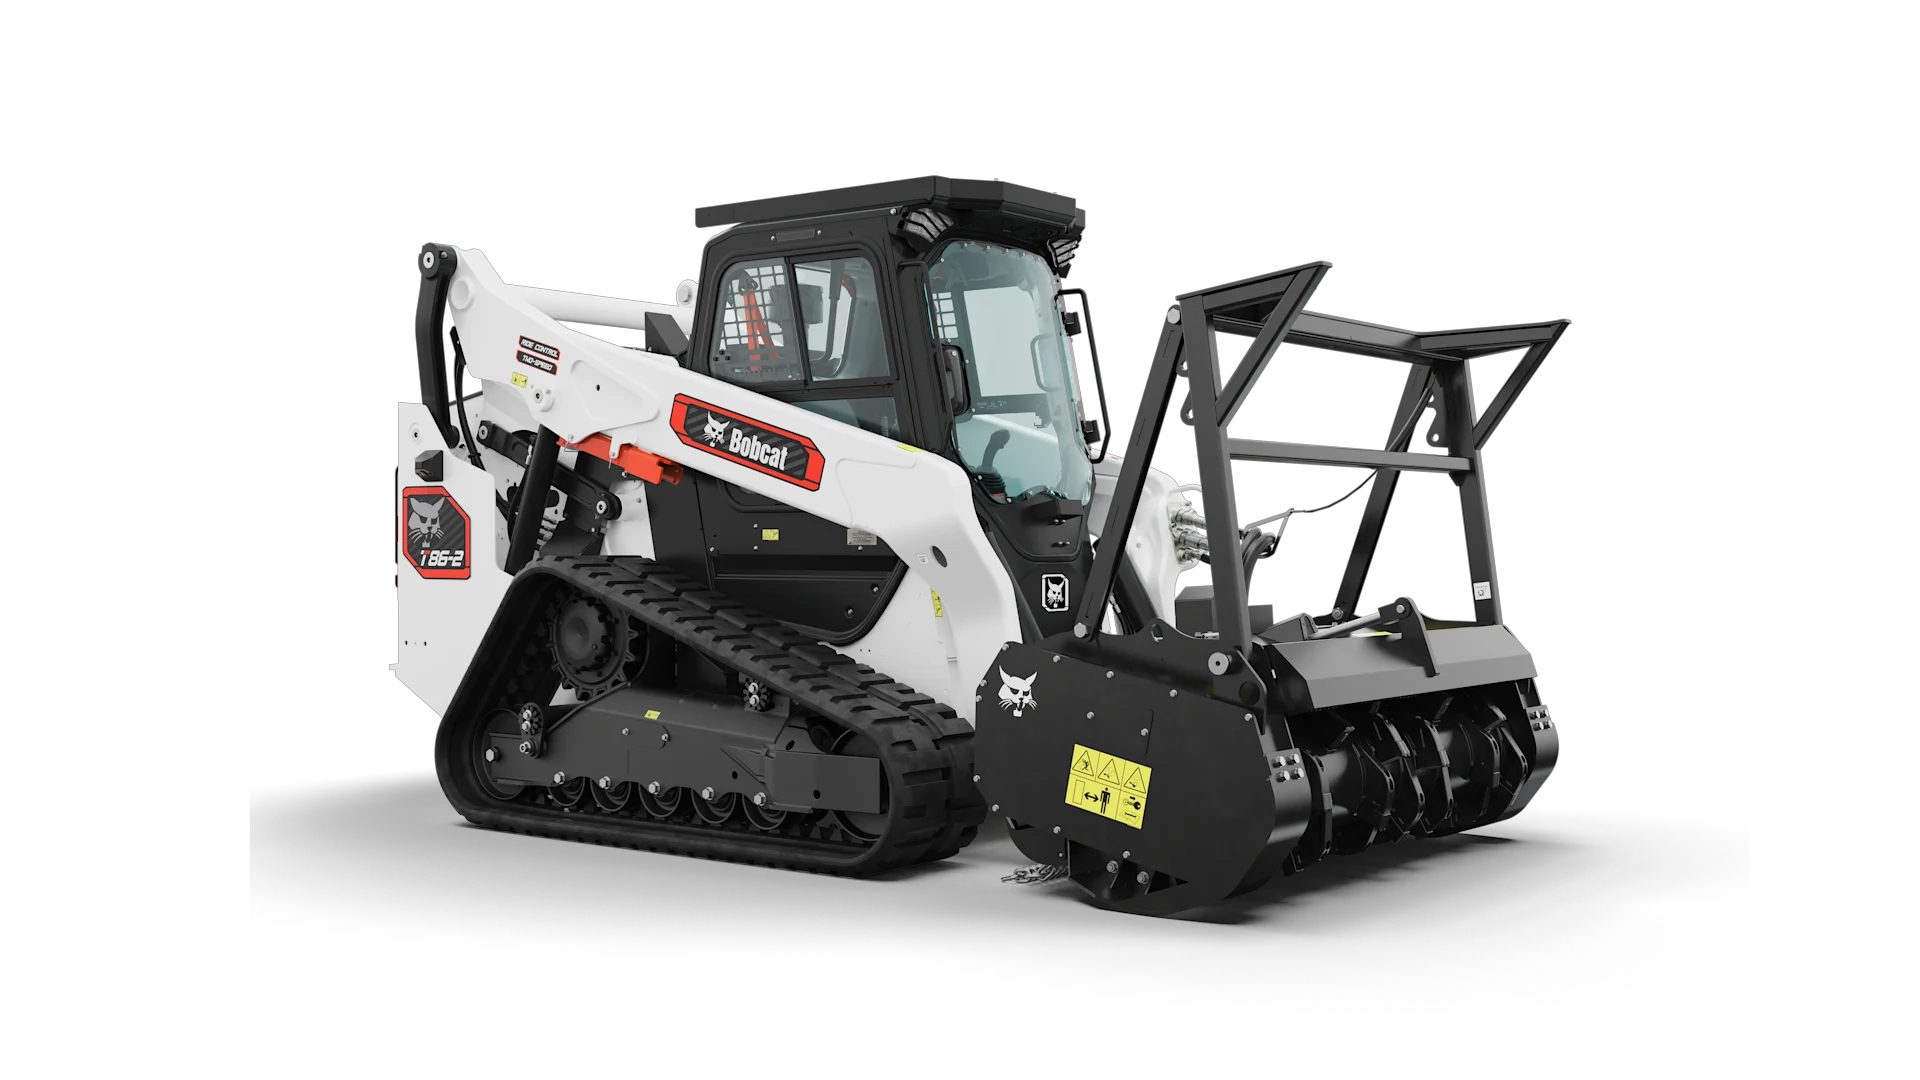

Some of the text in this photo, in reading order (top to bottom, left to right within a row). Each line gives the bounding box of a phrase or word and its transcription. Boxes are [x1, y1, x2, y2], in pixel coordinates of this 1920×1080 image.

[521, 338, 558, 358] RIDE CONTROL
[522, 354, 553, 370] TWO-SPEED
[729, 427, 788, 471] Bobcat
[420, 549, 464, 567] T86-2
